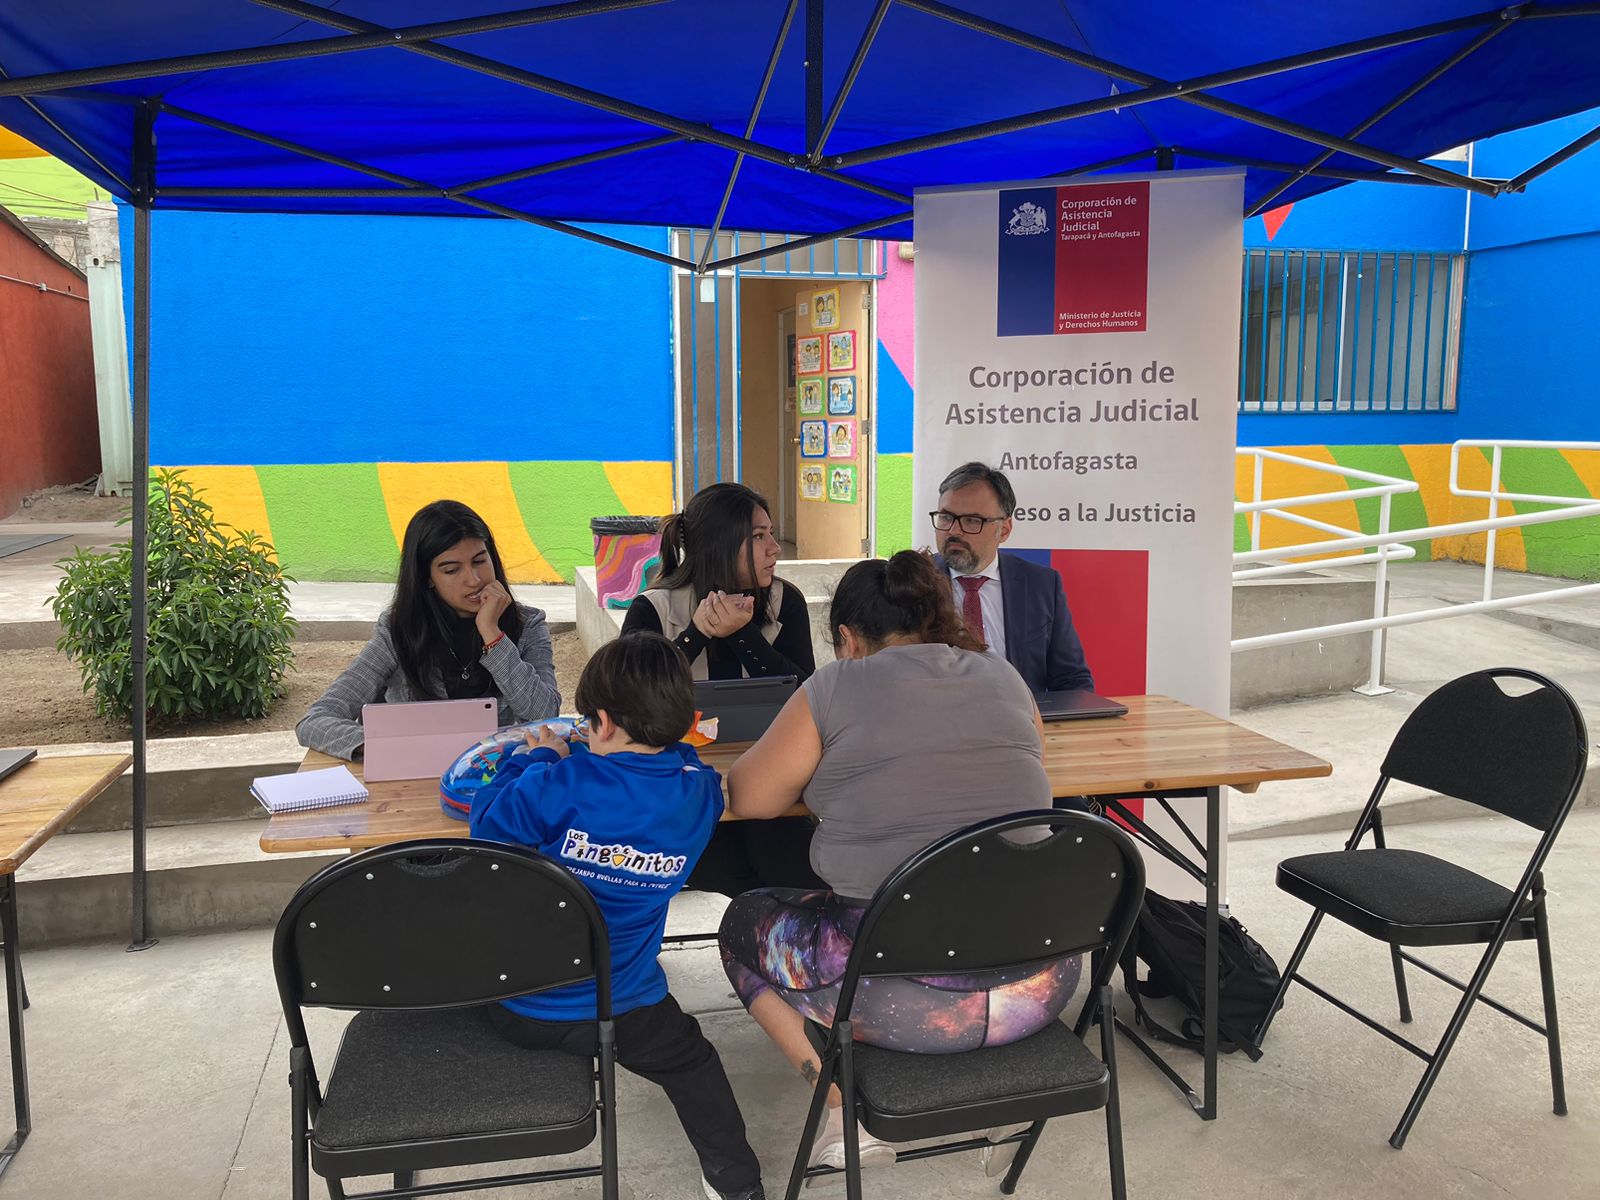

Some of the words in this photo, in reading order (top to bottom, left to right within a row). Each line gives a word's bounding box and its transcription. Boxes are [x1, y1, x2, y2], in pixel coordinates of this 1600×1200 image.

[1061, 196, 1122, 210] Corporación
[1124, 196, 1137, 206] de
[1061, 209, 1113, 221] Asistencia
[1060, 221, 1100, 232] Judicial
[1060, 232, 1091, 241] Tarapacá
[1097, 230, 1141, 239] Antofagasta
[1059, 311, 1099, 320] Ministerio
[1099, 311, 1110, 319] de
[1111, 310, 1142, 318] Justicia
[1058, 322, 1064, 331] y
[1065, 320, 1101, 329] Derechos
[1101, 319, 1138, 328] Humanos
[968, 361, 1132, 392] Corporación
[1140, 360, 1175, 384] de
[944, 400, 1081, 426] Asistencia
[1089, 398, 1199, 424] Judicial
[999, 450, 1138, 475] Antofagasta
[1013, 507, 1052, 522] eso
[1057, 507, 1070, 522] a
[1077, 502, 1098, 523] la
[1104, 502, 1196, 523] Justicia
[568, 831, 584, 841] LOS
